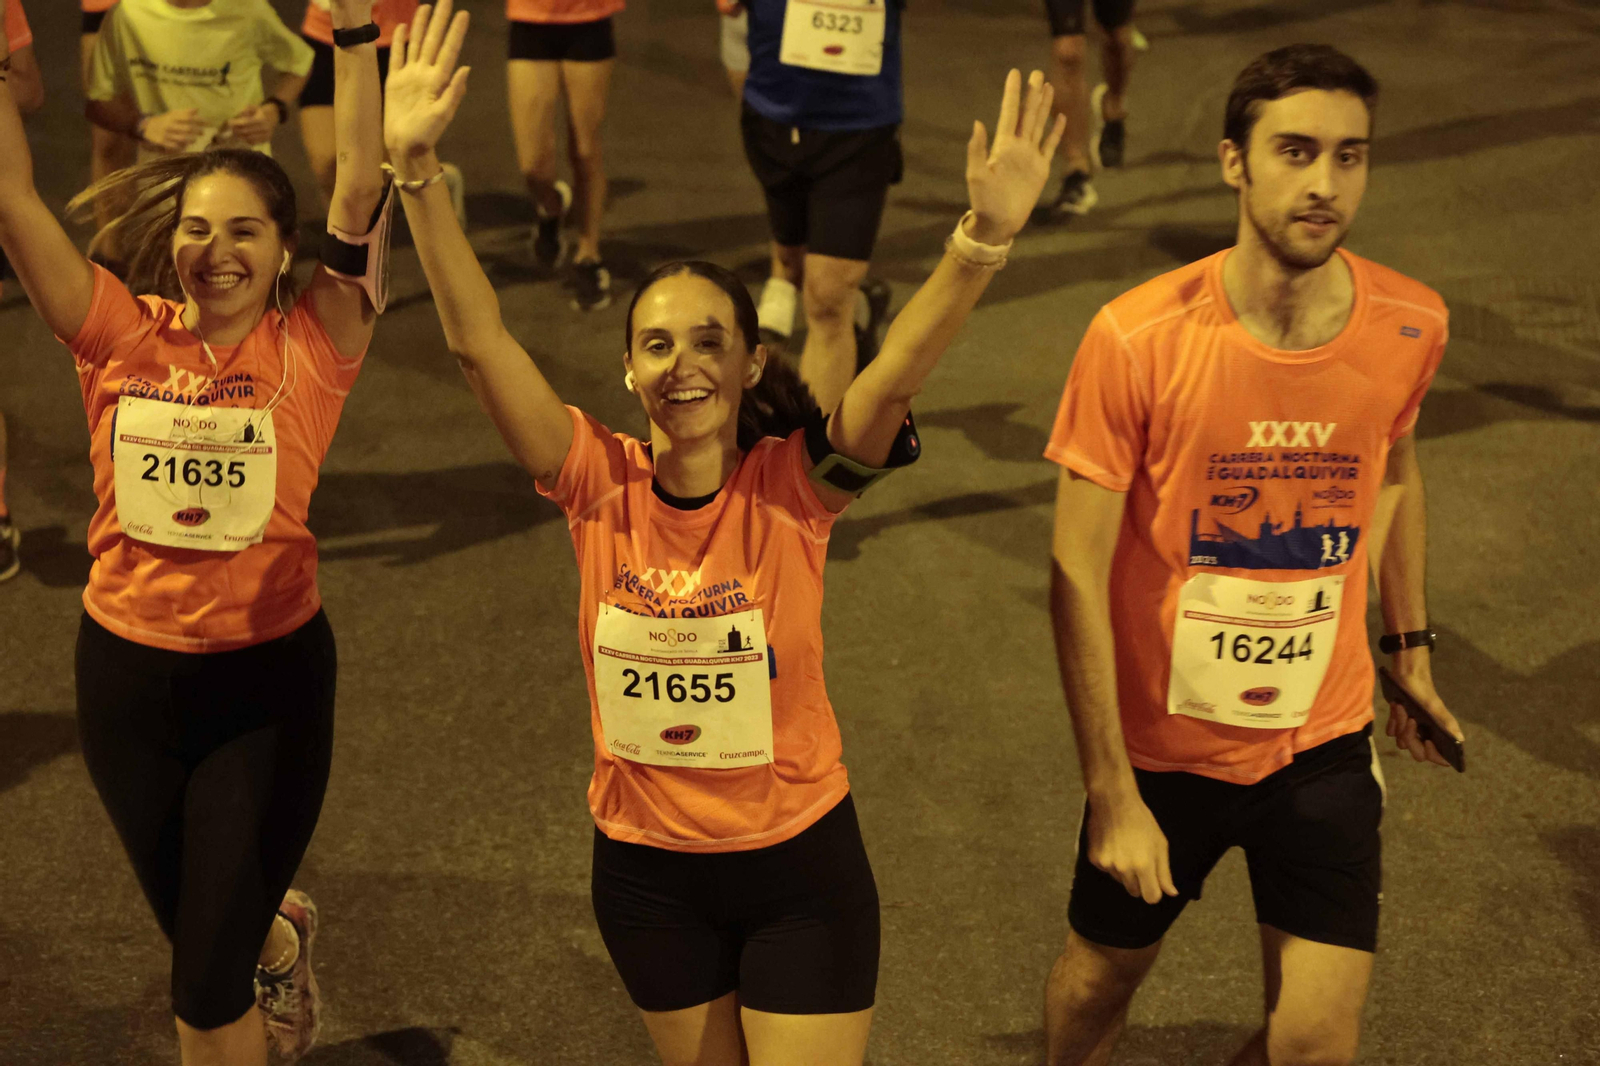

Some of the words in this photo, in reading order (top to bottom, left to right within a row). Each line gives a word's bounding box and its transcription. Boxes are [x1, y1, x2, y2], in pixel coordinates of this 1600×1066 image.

[812, 11, 863, 34] 6323
[1245, 421, 1337, 448] XXXV
[141, 453, 246, 488] 21635
[1208, 452, 1275, 464] CARRERA
[1281, 452, 1361, 464] NOCTURNA
[1217, 466, 1359, 480] GUADALQUIVIR
[668, 577, 743, 607] NOCTURNA
[600, 647, 615, 656] XXXV
[614, 651, 640, 661] CARRERA
[639, 655, 672, 665] NOCTURNA
[683, 657, 731, 665] GUADALQUIVIR
[743, 654, 759, 662] 2023
[1210, 631, 1315, 664] 16244
[622, 668, 736, 703] 21655
[719, 749, 765, 760] Cruzcampo
